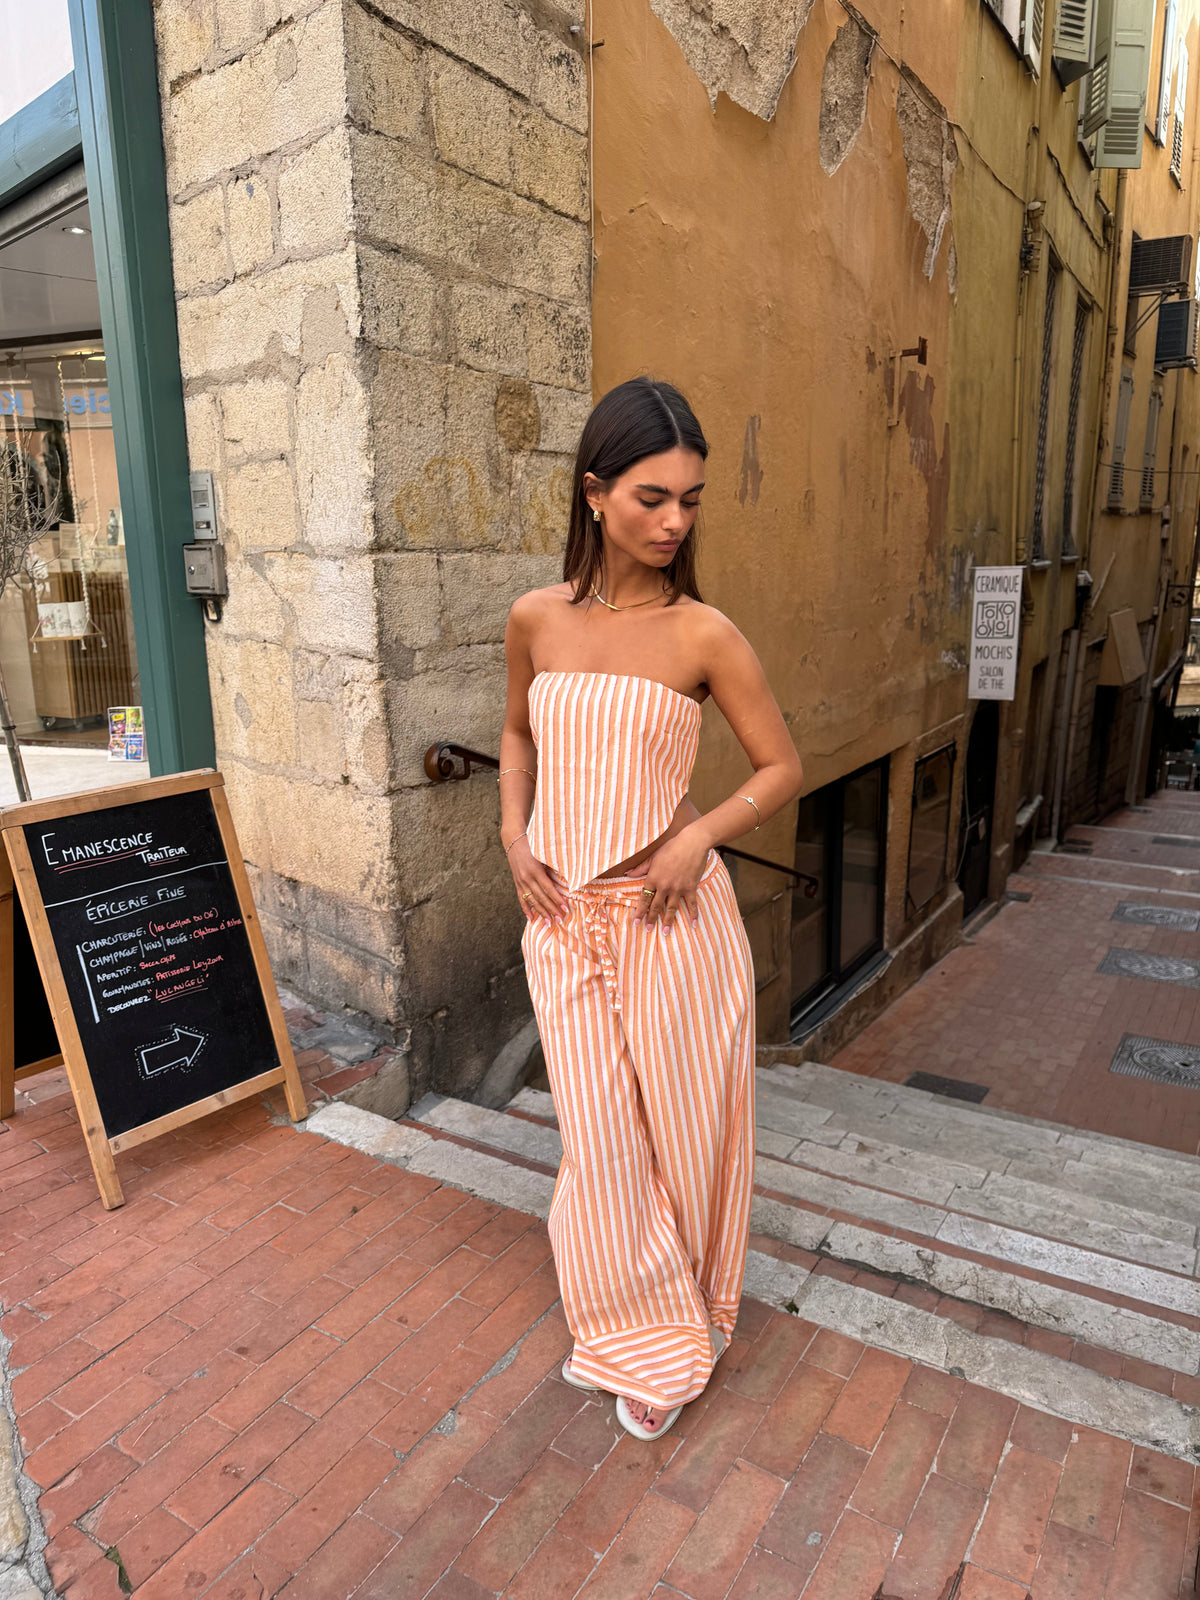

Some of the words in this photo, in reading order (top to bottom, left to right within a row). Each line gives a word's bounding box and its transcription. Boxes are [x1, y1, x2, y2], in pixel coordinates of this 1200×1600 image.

[975, 574, 1020, 595] CERAMIQUE
[974, 645, 1013, 660] MOCHIS
[979, 665, 1004, 677] SALON
[977, 679, 988, 690] DE
[991, 678, 1005, 690] THE
